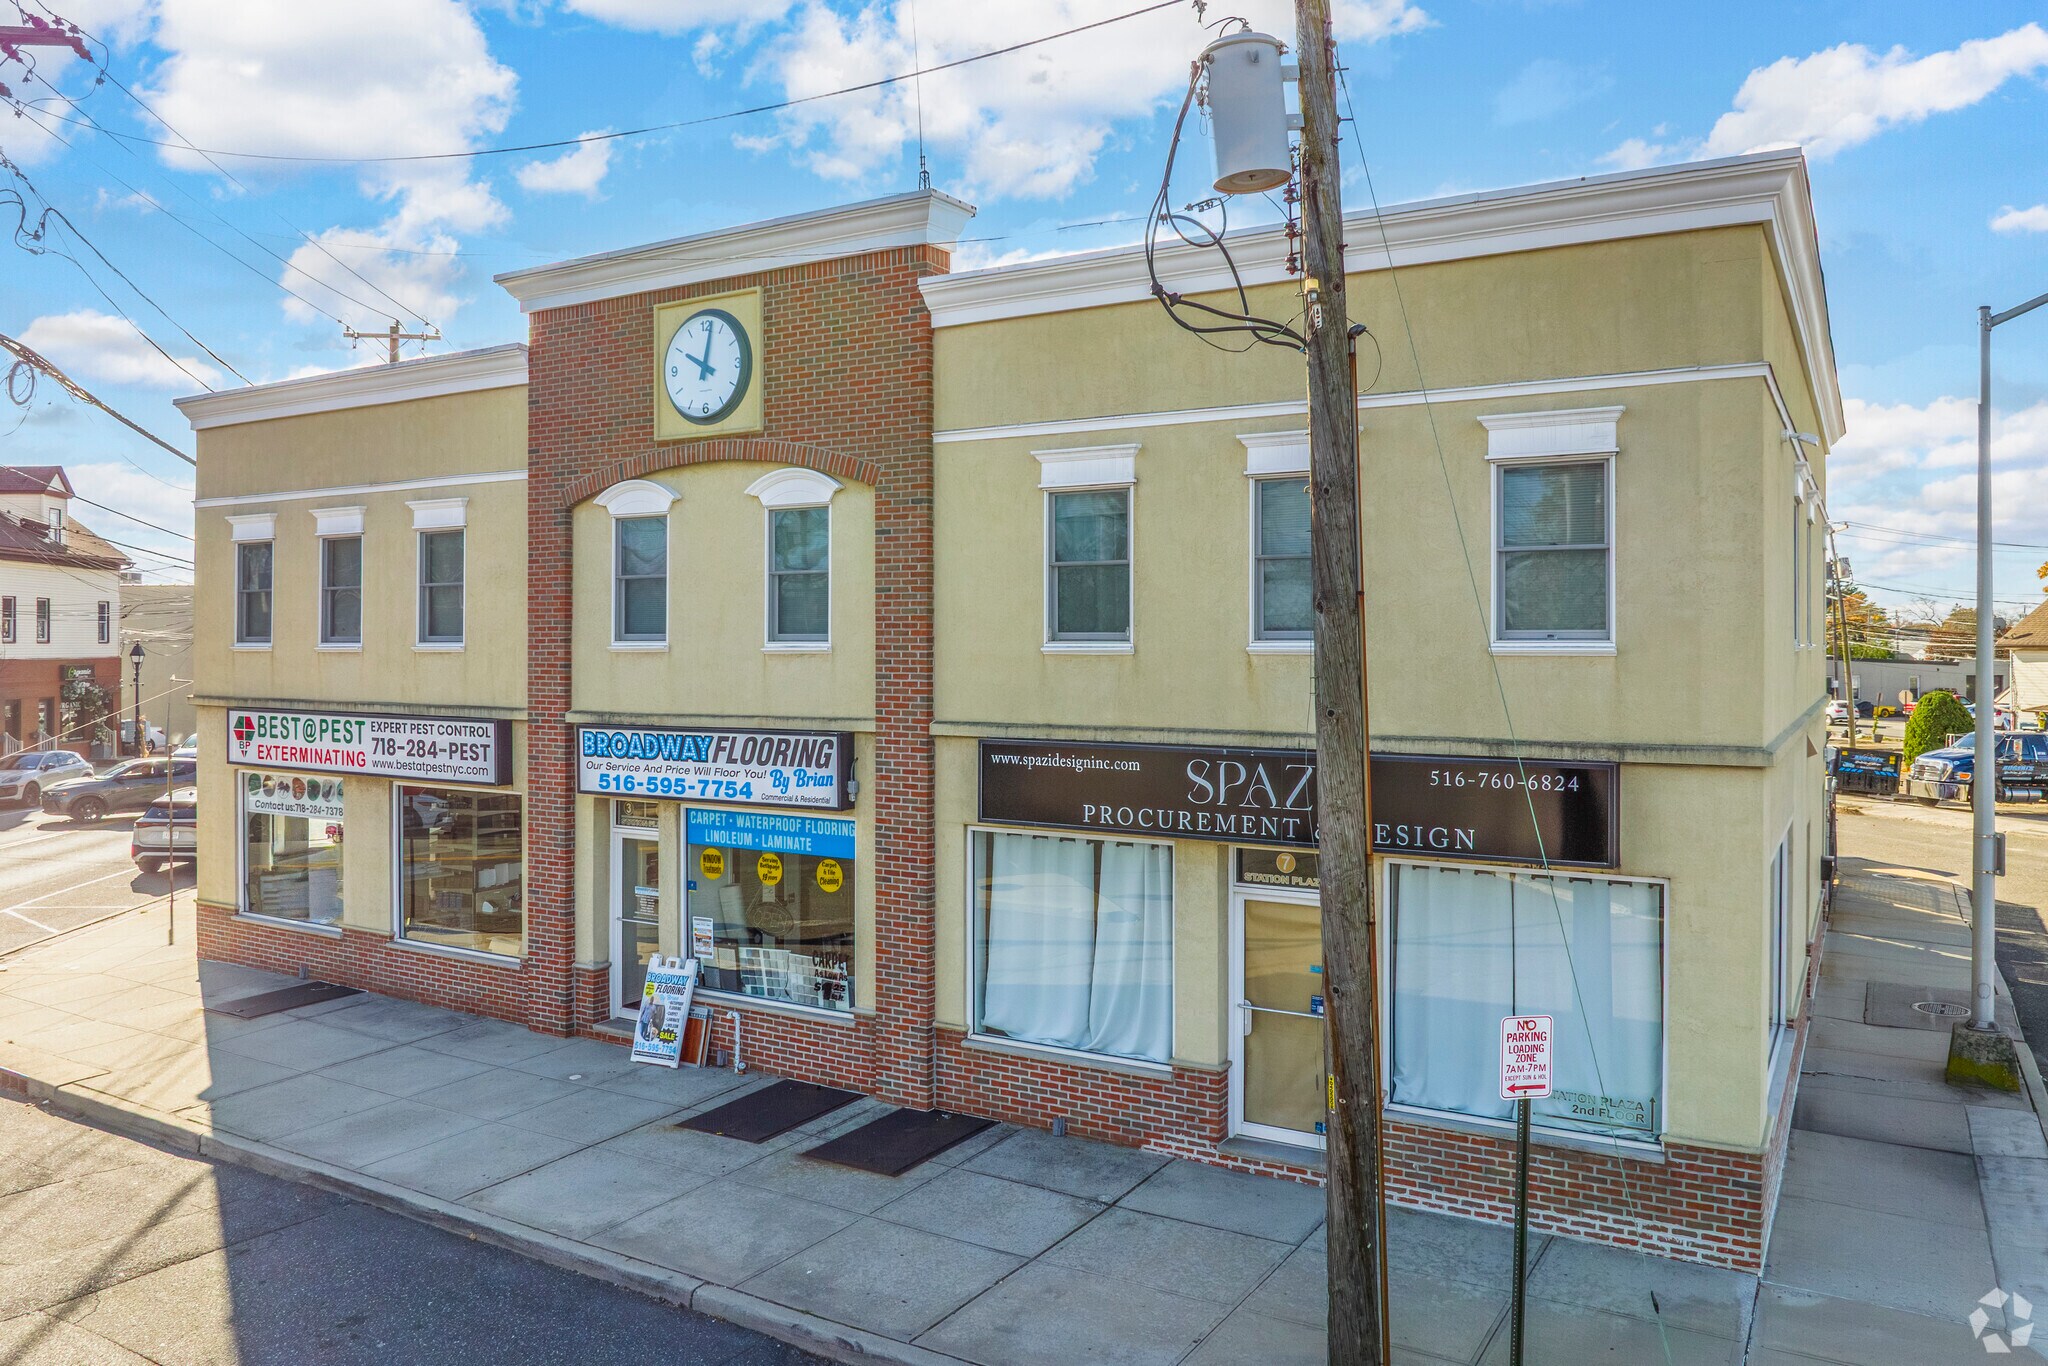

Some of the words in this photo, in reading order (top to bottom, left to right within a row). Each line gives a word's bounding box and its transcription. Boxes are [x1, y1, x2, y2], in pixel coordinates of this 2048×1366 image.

[700, 320, 712, 332] 12
[734, 357, 740, 368] 3
[671, 366, 678, 377] 9
[702, 402, 709, 414] 6
[258, 715, 366, 744] BEST@PEST
[371, 721, 408, 733] EXPERT
[410, 723, 434, 735] PEST
[437, 724, 490, 738] CONTROL
[239, 741, 250, 749] BP
[372, 737, 490, 762] 718-284-PEST
[582, 731, 714, 762] BROADWAY
[712, 736, 834, 769] FLOORING
[258, 745, 366, 767] EXTERMINATING
[991, 753, 1140, 772] www.spazidesigninc.com
[372, 760, 488, 777] www.bestatpestnyc.com
[586, 761, 603, 770] Our
[605, 762, 640, 772] Service
[643, 764, 662, 774] And
[665, 765, 690, 775] Price
[694, 766, 711, 776] Will
[714, 768, 740, 777] Floor
[744, 770, 767, 779] You!
[598, 774, 753, 799] 516-595-7754
[770, 769, 790, 794] By
[793, 768, 833, 787] Brian
[1186, 759, 1317, 811] SPAZ
[1430, 770, 1579, 792] 516-760-6824
[255, 800, 284, 810] Contact
[761, 793, 793, 802] Commercial
[801, 796, 831, 804] Residential
[626, 803, 632, 813] 3
[690, 811, 726, 826] CARPET
[736, 814, 801, 832] WATERPROOF
[805, 821, 856, 837] FLOORING
[1083, 804, 1300, 838] PROCUREMENT
[705, 829, 752, 846] LINOLEUM
[762, 834, 812, 851] LAMINATE
[1375, 824, 1475, 849] ESIGN
[1282, 856, 1290, 870] 7
[1244, 872, 1289, 884] STATION
[1292, 876, 1320, 886] PLAZ
[647, 972, 689, 986] BROADWAY
[655, 984, 686, 995] FLOORING
[1517, 1020, 1536, 1031] NO
[660, 1032, 676, 1040] SALE
[1506, 1031, 1547, 1042] PARKING
[1508, 1044, 1544, 1054] LOADING
[1516, 1053, 1537, 1062] ZONE
[1506, 1064, 1546, 1073] 7AM-7PM
[1552, 1090, 1596, 1105] TATION
[1600, 1097, 1644, 1112] PLAZA
[1572, 1104, 1595, 1116] 2nd
[1599, 1108, 1644, 1123] FLOOR
